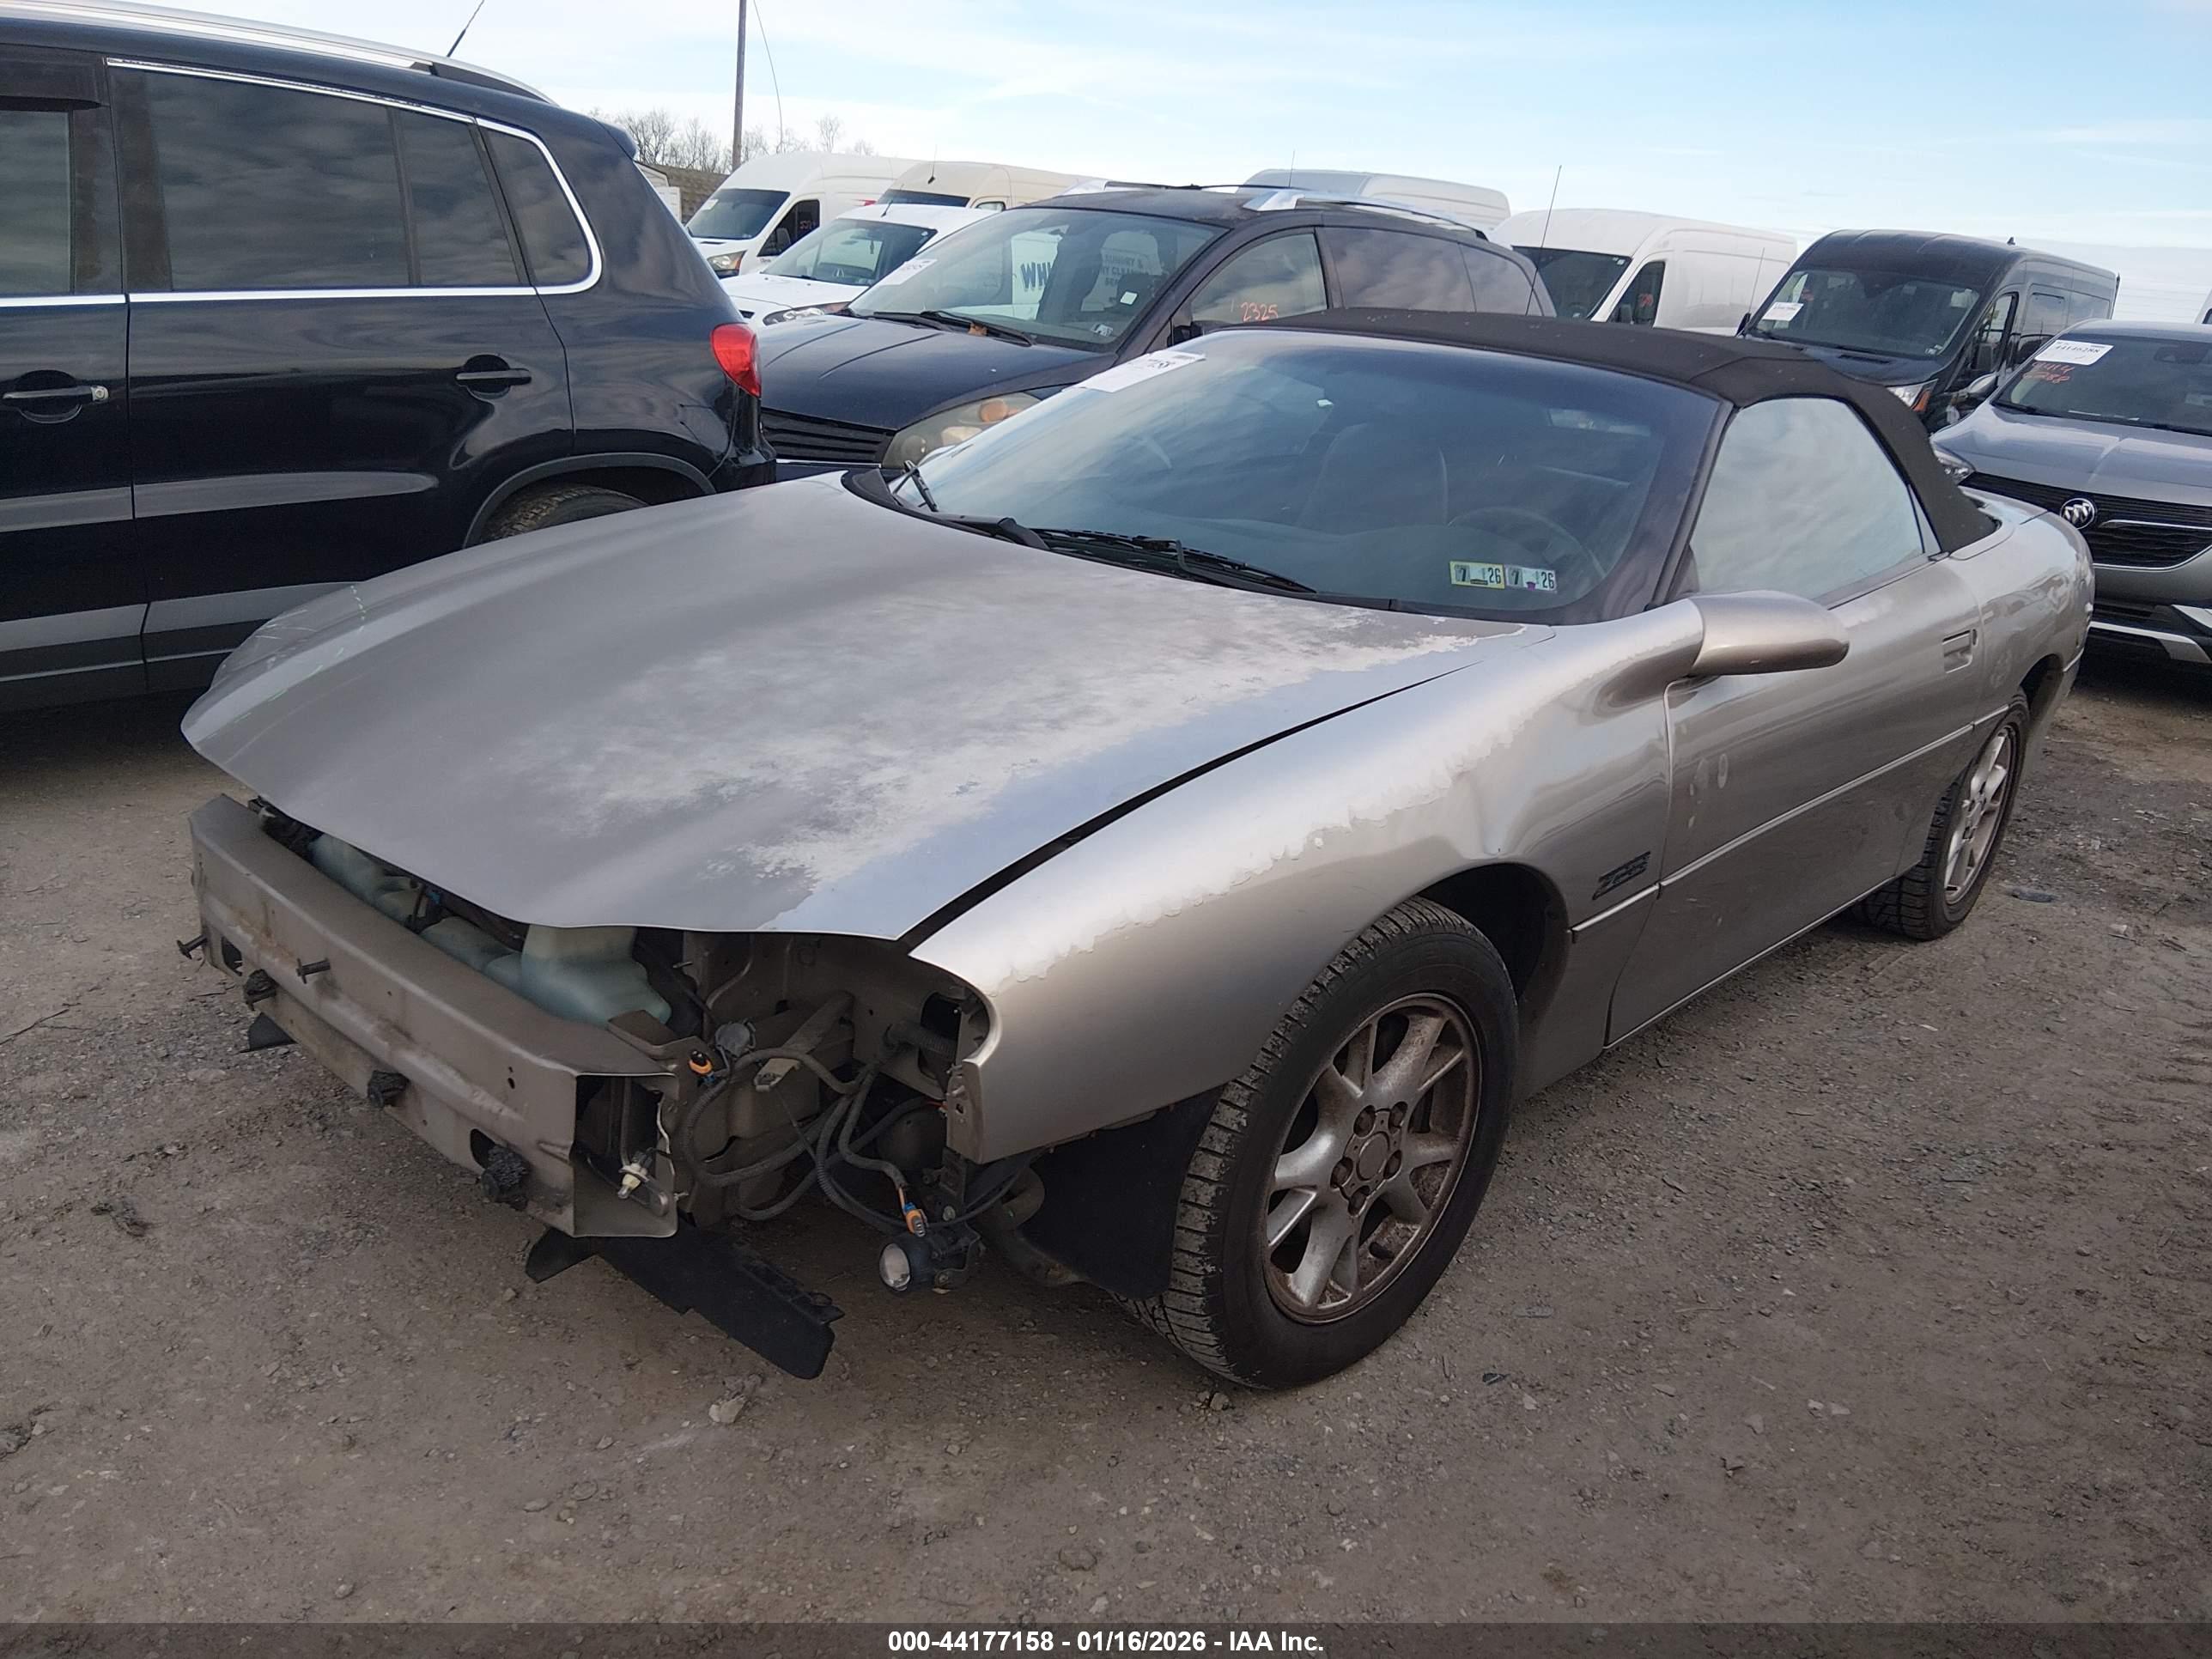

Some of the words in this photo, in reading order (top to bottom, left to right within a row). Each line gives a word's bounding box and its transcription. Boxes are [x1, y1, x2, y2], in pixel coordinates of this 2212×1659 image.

[1241, 302, 1278, 322] 2325
[1487, 567, 1501, 584] 26
[1541, 571, 1554, 588] 26
